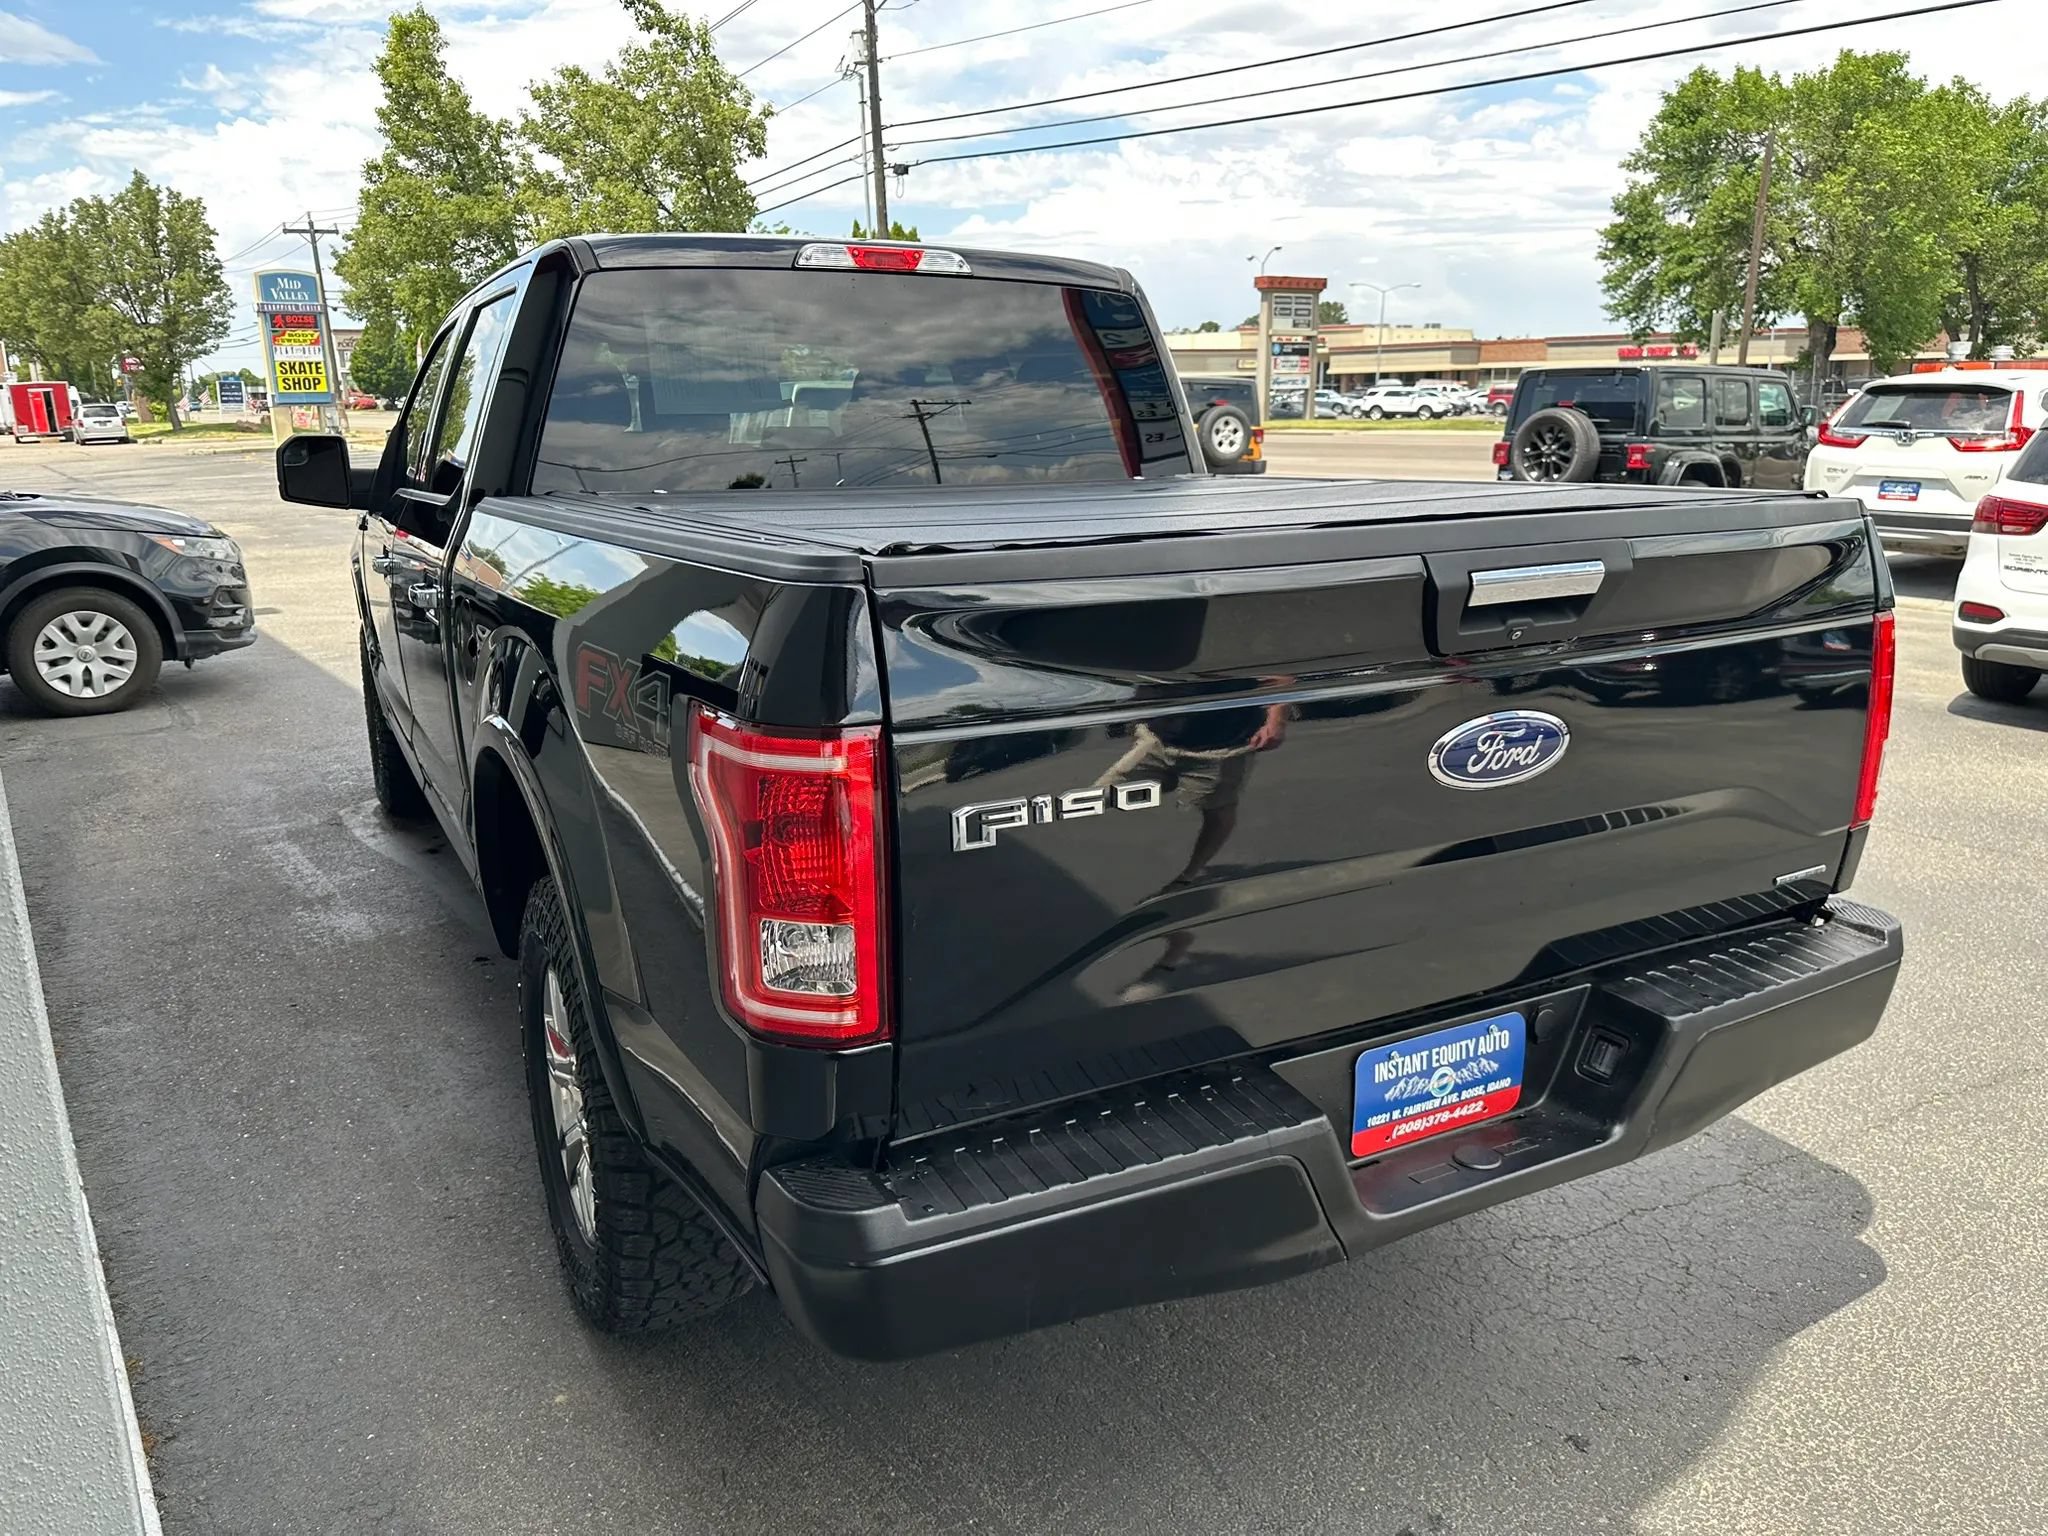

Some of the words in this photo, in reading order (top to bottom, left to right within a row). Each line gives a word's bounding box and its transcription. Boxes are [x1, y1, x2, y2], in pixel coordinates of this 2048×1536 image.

[270, 287, 310, 301] VALLEY
[286, 315, 316, 323] BOISE
[279, 361, 323, 376] SKATE
[282, 377, 322, 391] SHOP
[576, 640, 671, 750] FX4
[1467, 728, 1544, 774] Ford
[1374, 1051, 1429, 1084] INSTANT
[1431, 1037, 1476, 1067] EQUITY
[1478, 1030, 1510, 1056] AUTO
[1367, 1112, 1390, 1127] 10221
[1403, 1097, 1441, 1116] FAIRVIEW
[1487, 1077, 1512, 1092] IDAHO
[1392, 1100, 1485, 1140] (208)378-4422
